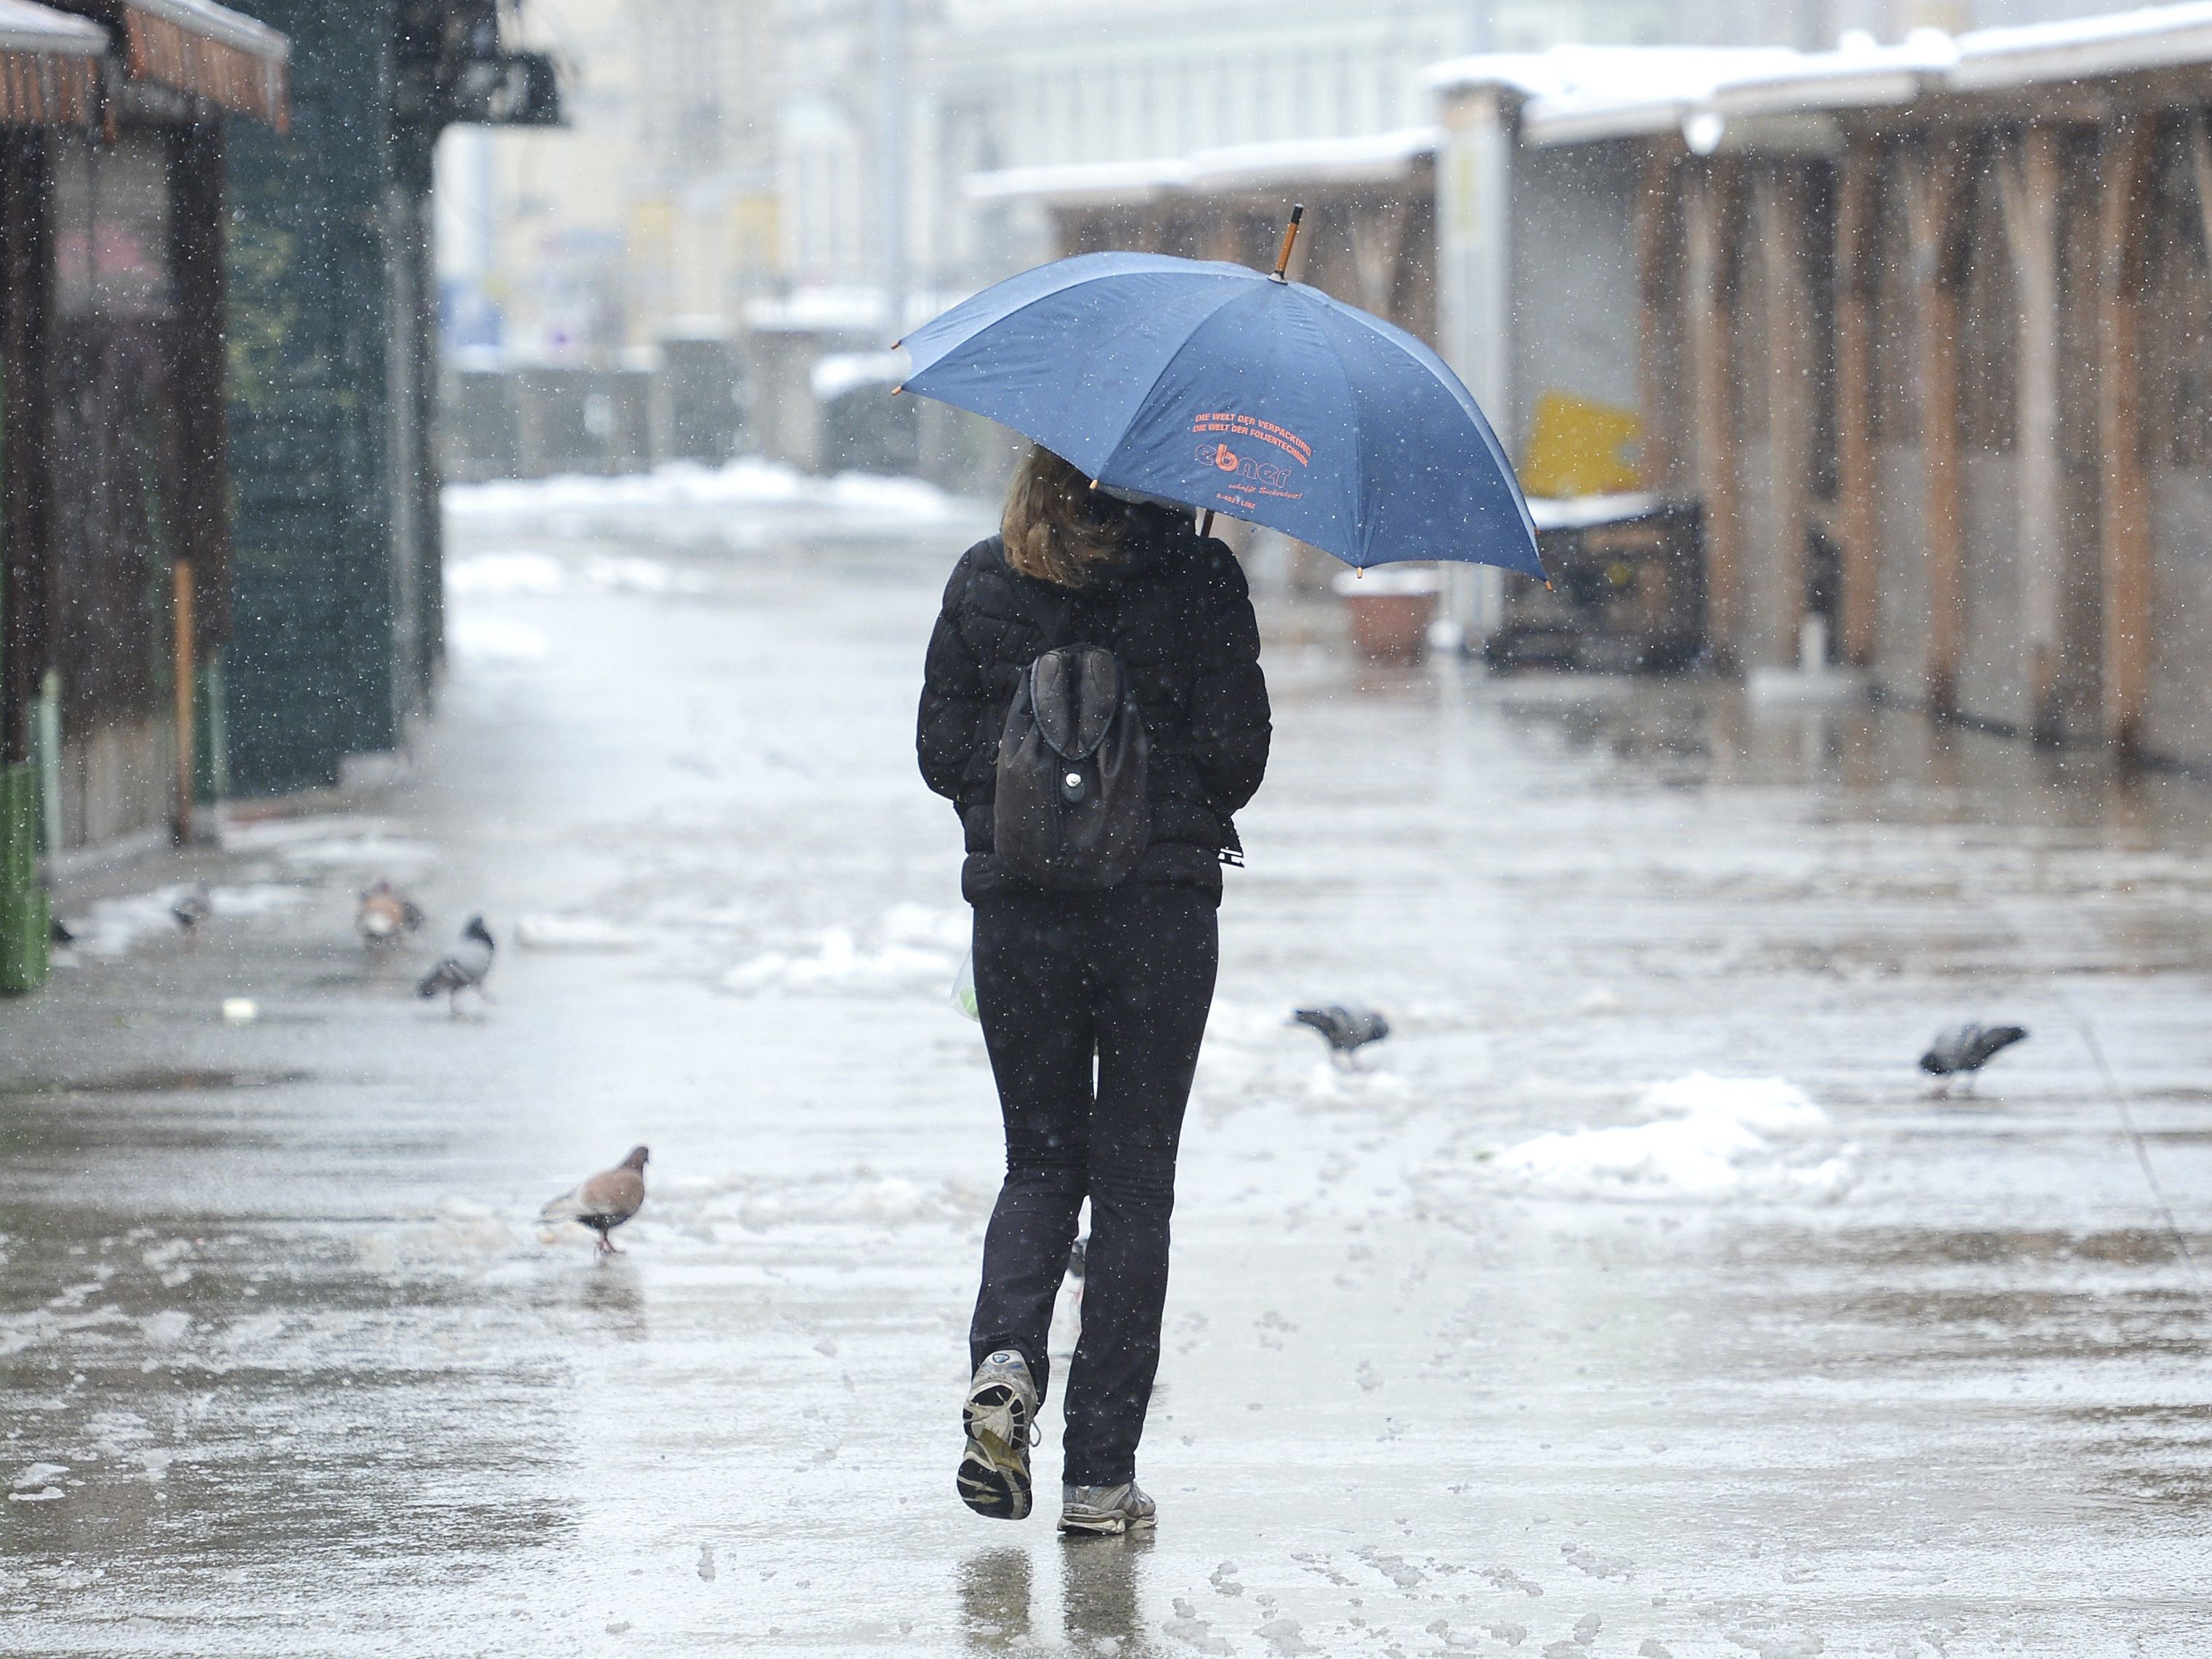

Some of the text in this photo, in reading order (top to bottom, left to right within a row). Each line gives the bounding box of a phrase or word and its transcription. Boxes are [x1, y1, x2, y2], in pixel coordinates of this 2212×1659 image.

[1195, 413, 1210, 422] DIE
[1237, 415, 1255, 425] DER
[1231, 425, 1248, 434] DER
